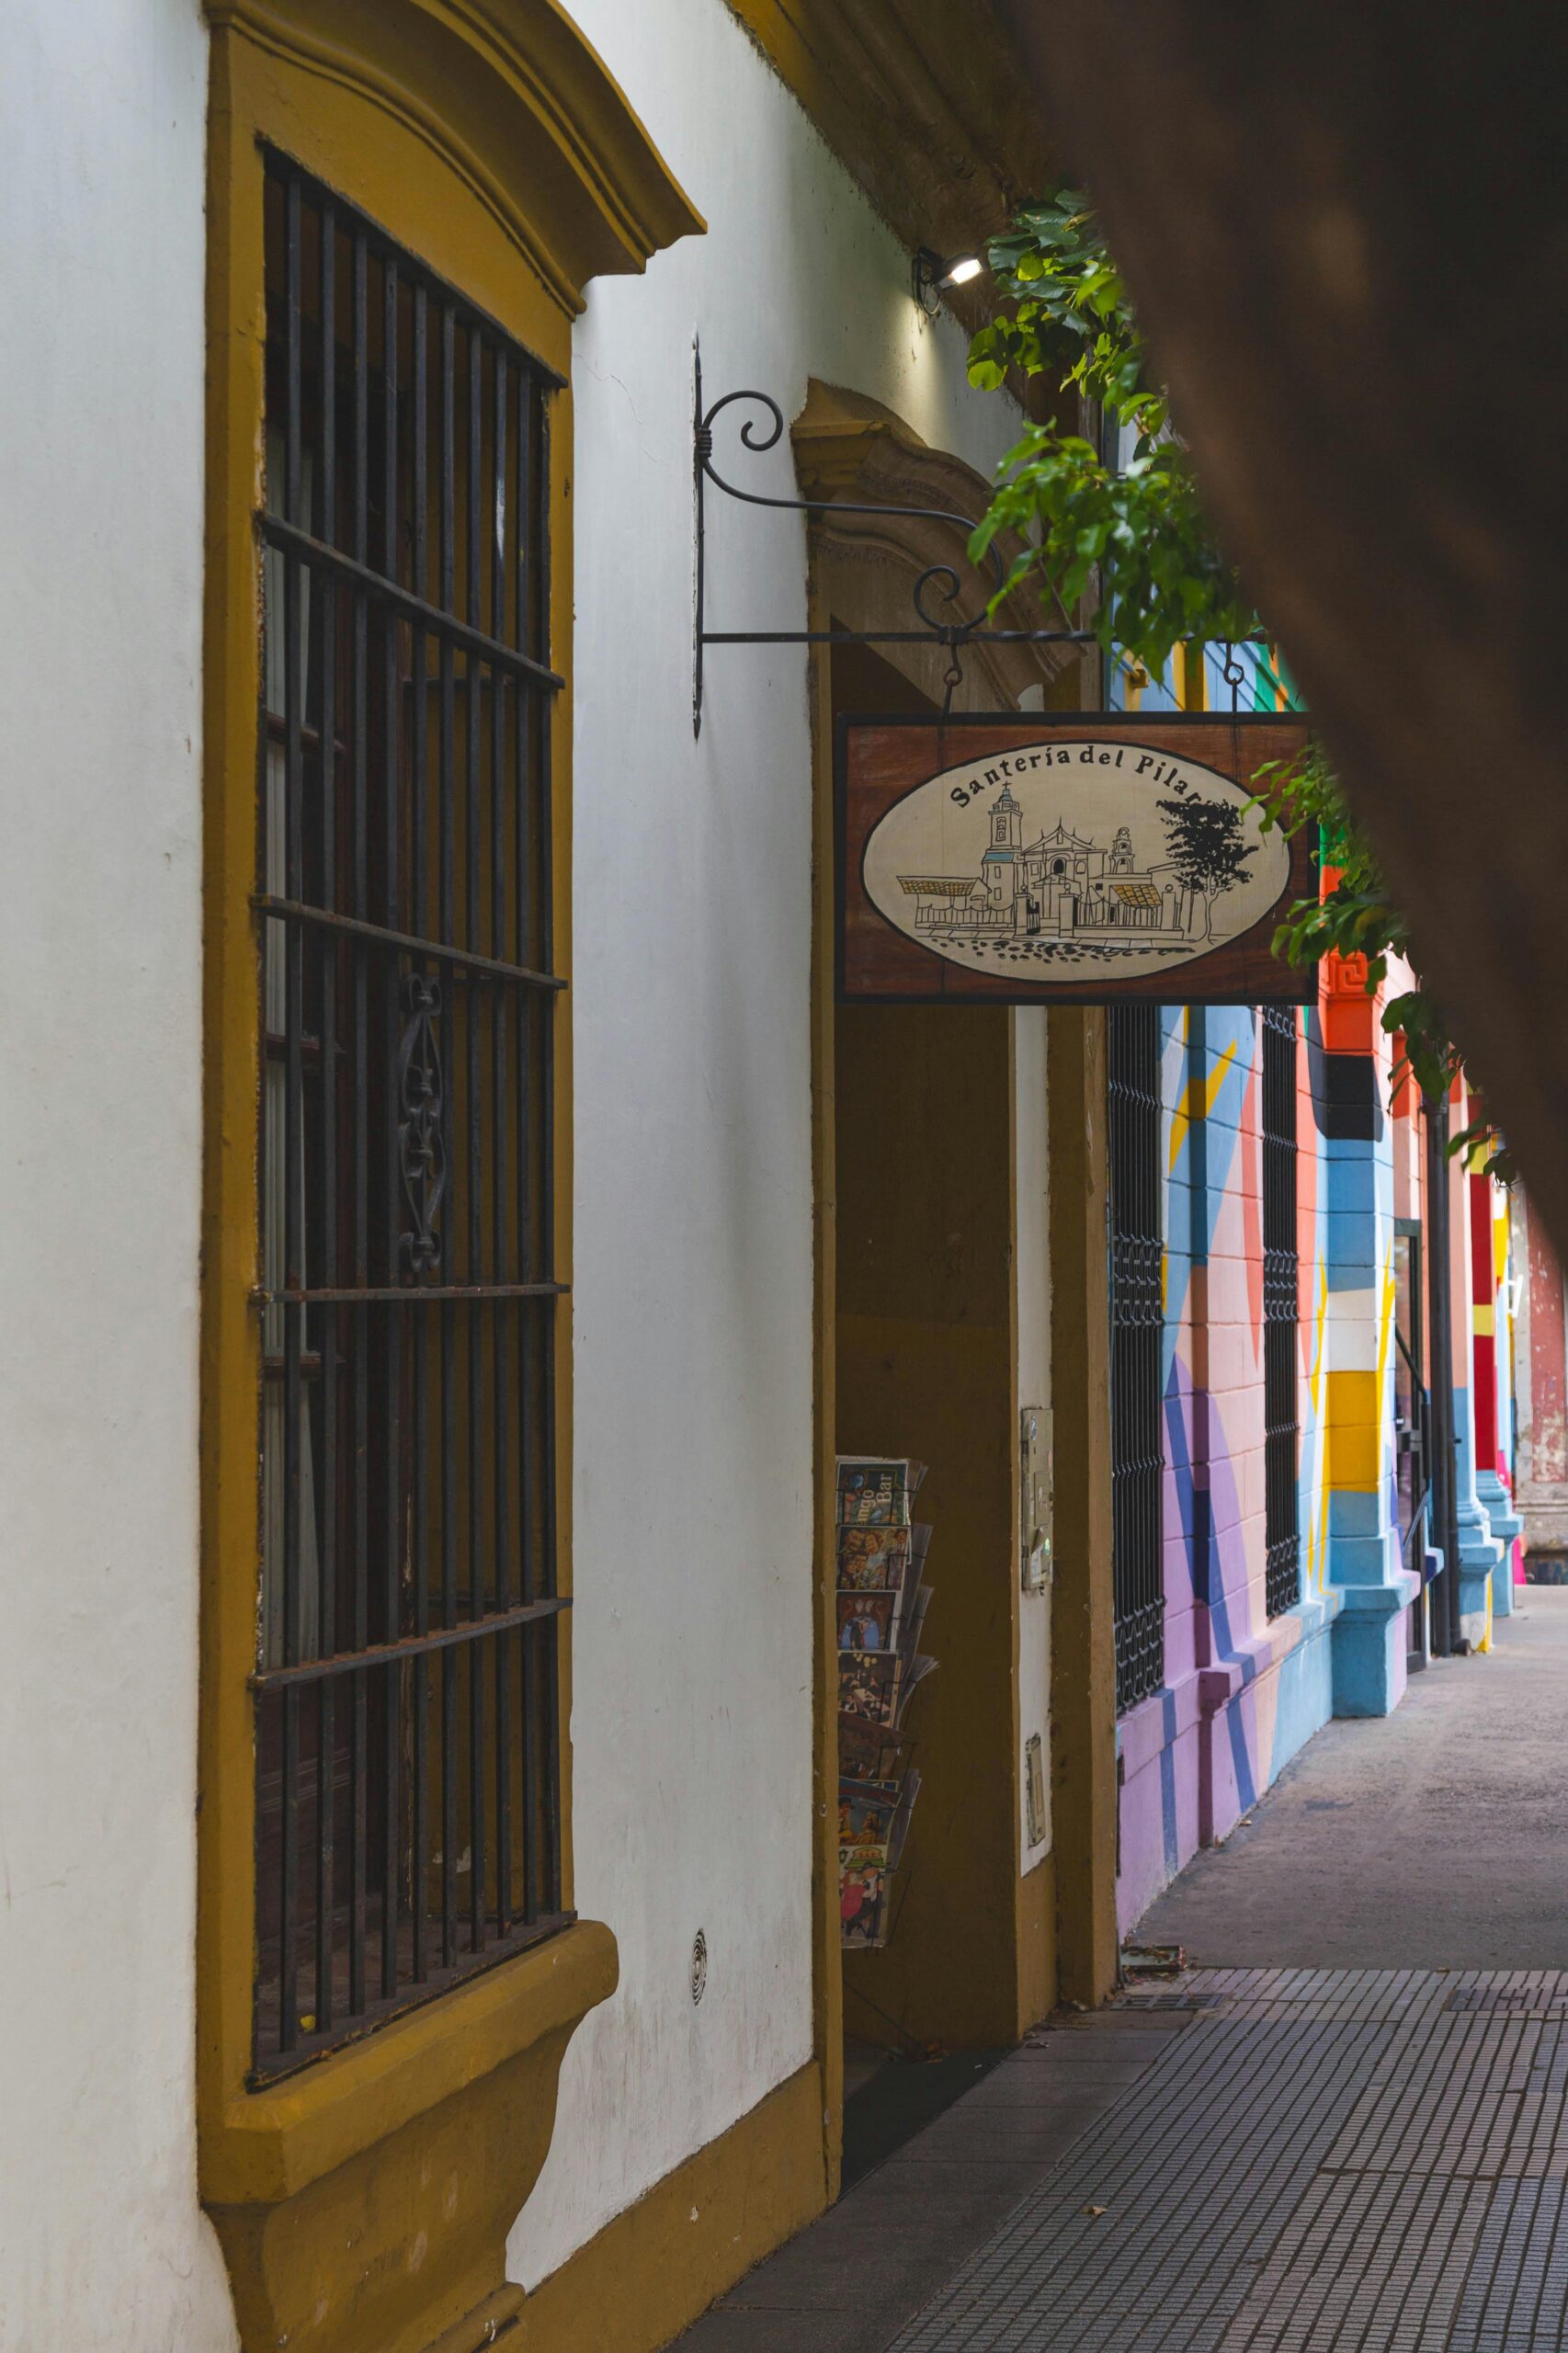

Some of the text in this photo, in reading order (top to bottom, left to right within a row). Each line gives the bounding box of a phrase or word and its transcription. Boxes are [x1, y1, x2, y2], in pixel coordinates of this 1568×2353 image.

[950, 745, 1201, 808] Santería del Pilar
[877, 1473, 892, 1503] Bar
[856, 1491, 876, 1525] ango
